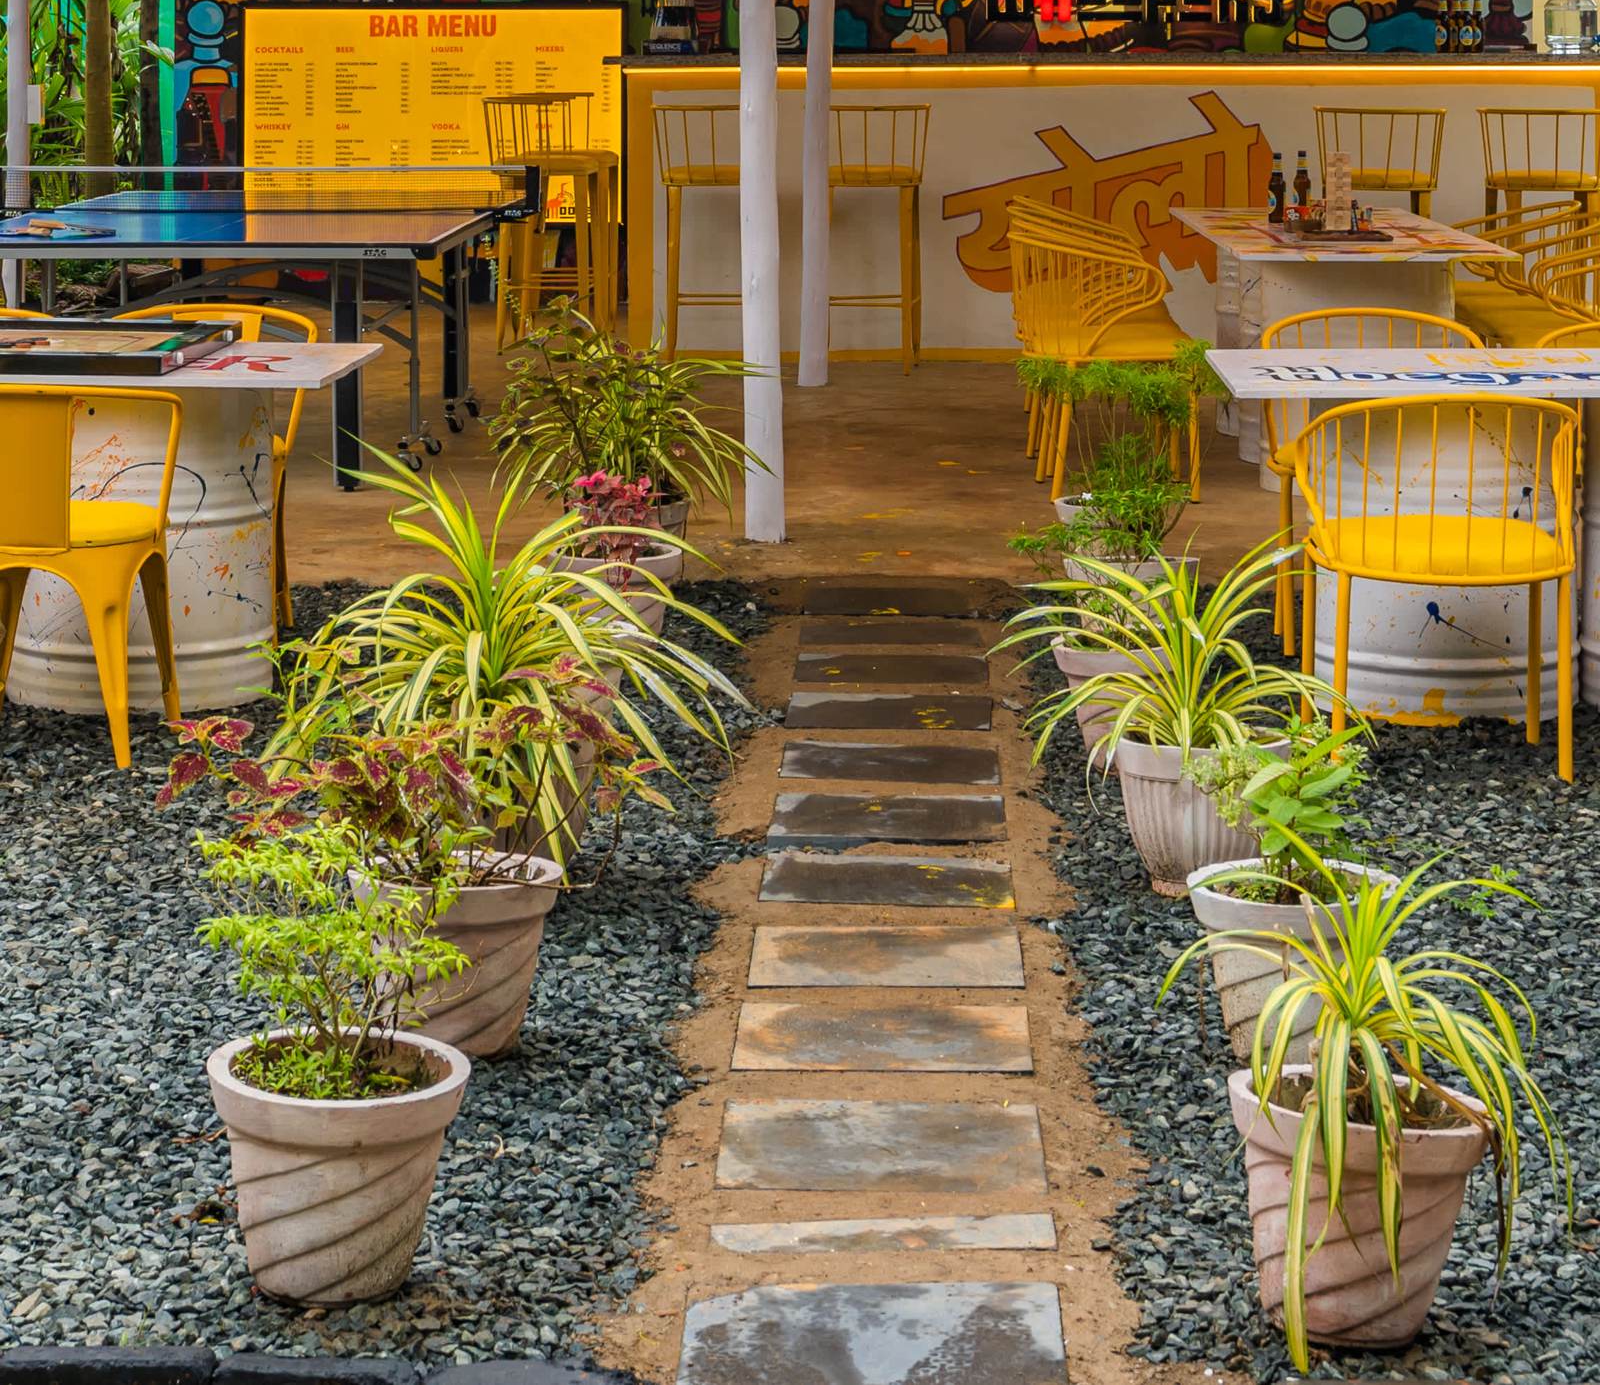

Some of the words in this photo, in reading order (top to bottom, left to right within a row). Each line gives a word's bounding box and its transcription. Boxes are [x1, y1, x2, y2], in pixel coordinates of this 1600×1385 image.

[369, 15, 418, 37] BAR
[427, 15, 497, 37] MENU
[255, 46, 304, 54] COCKTAILS
[255, 123, 292, 131] WHISKEY
[431, 123, 461, 131] VODKA
